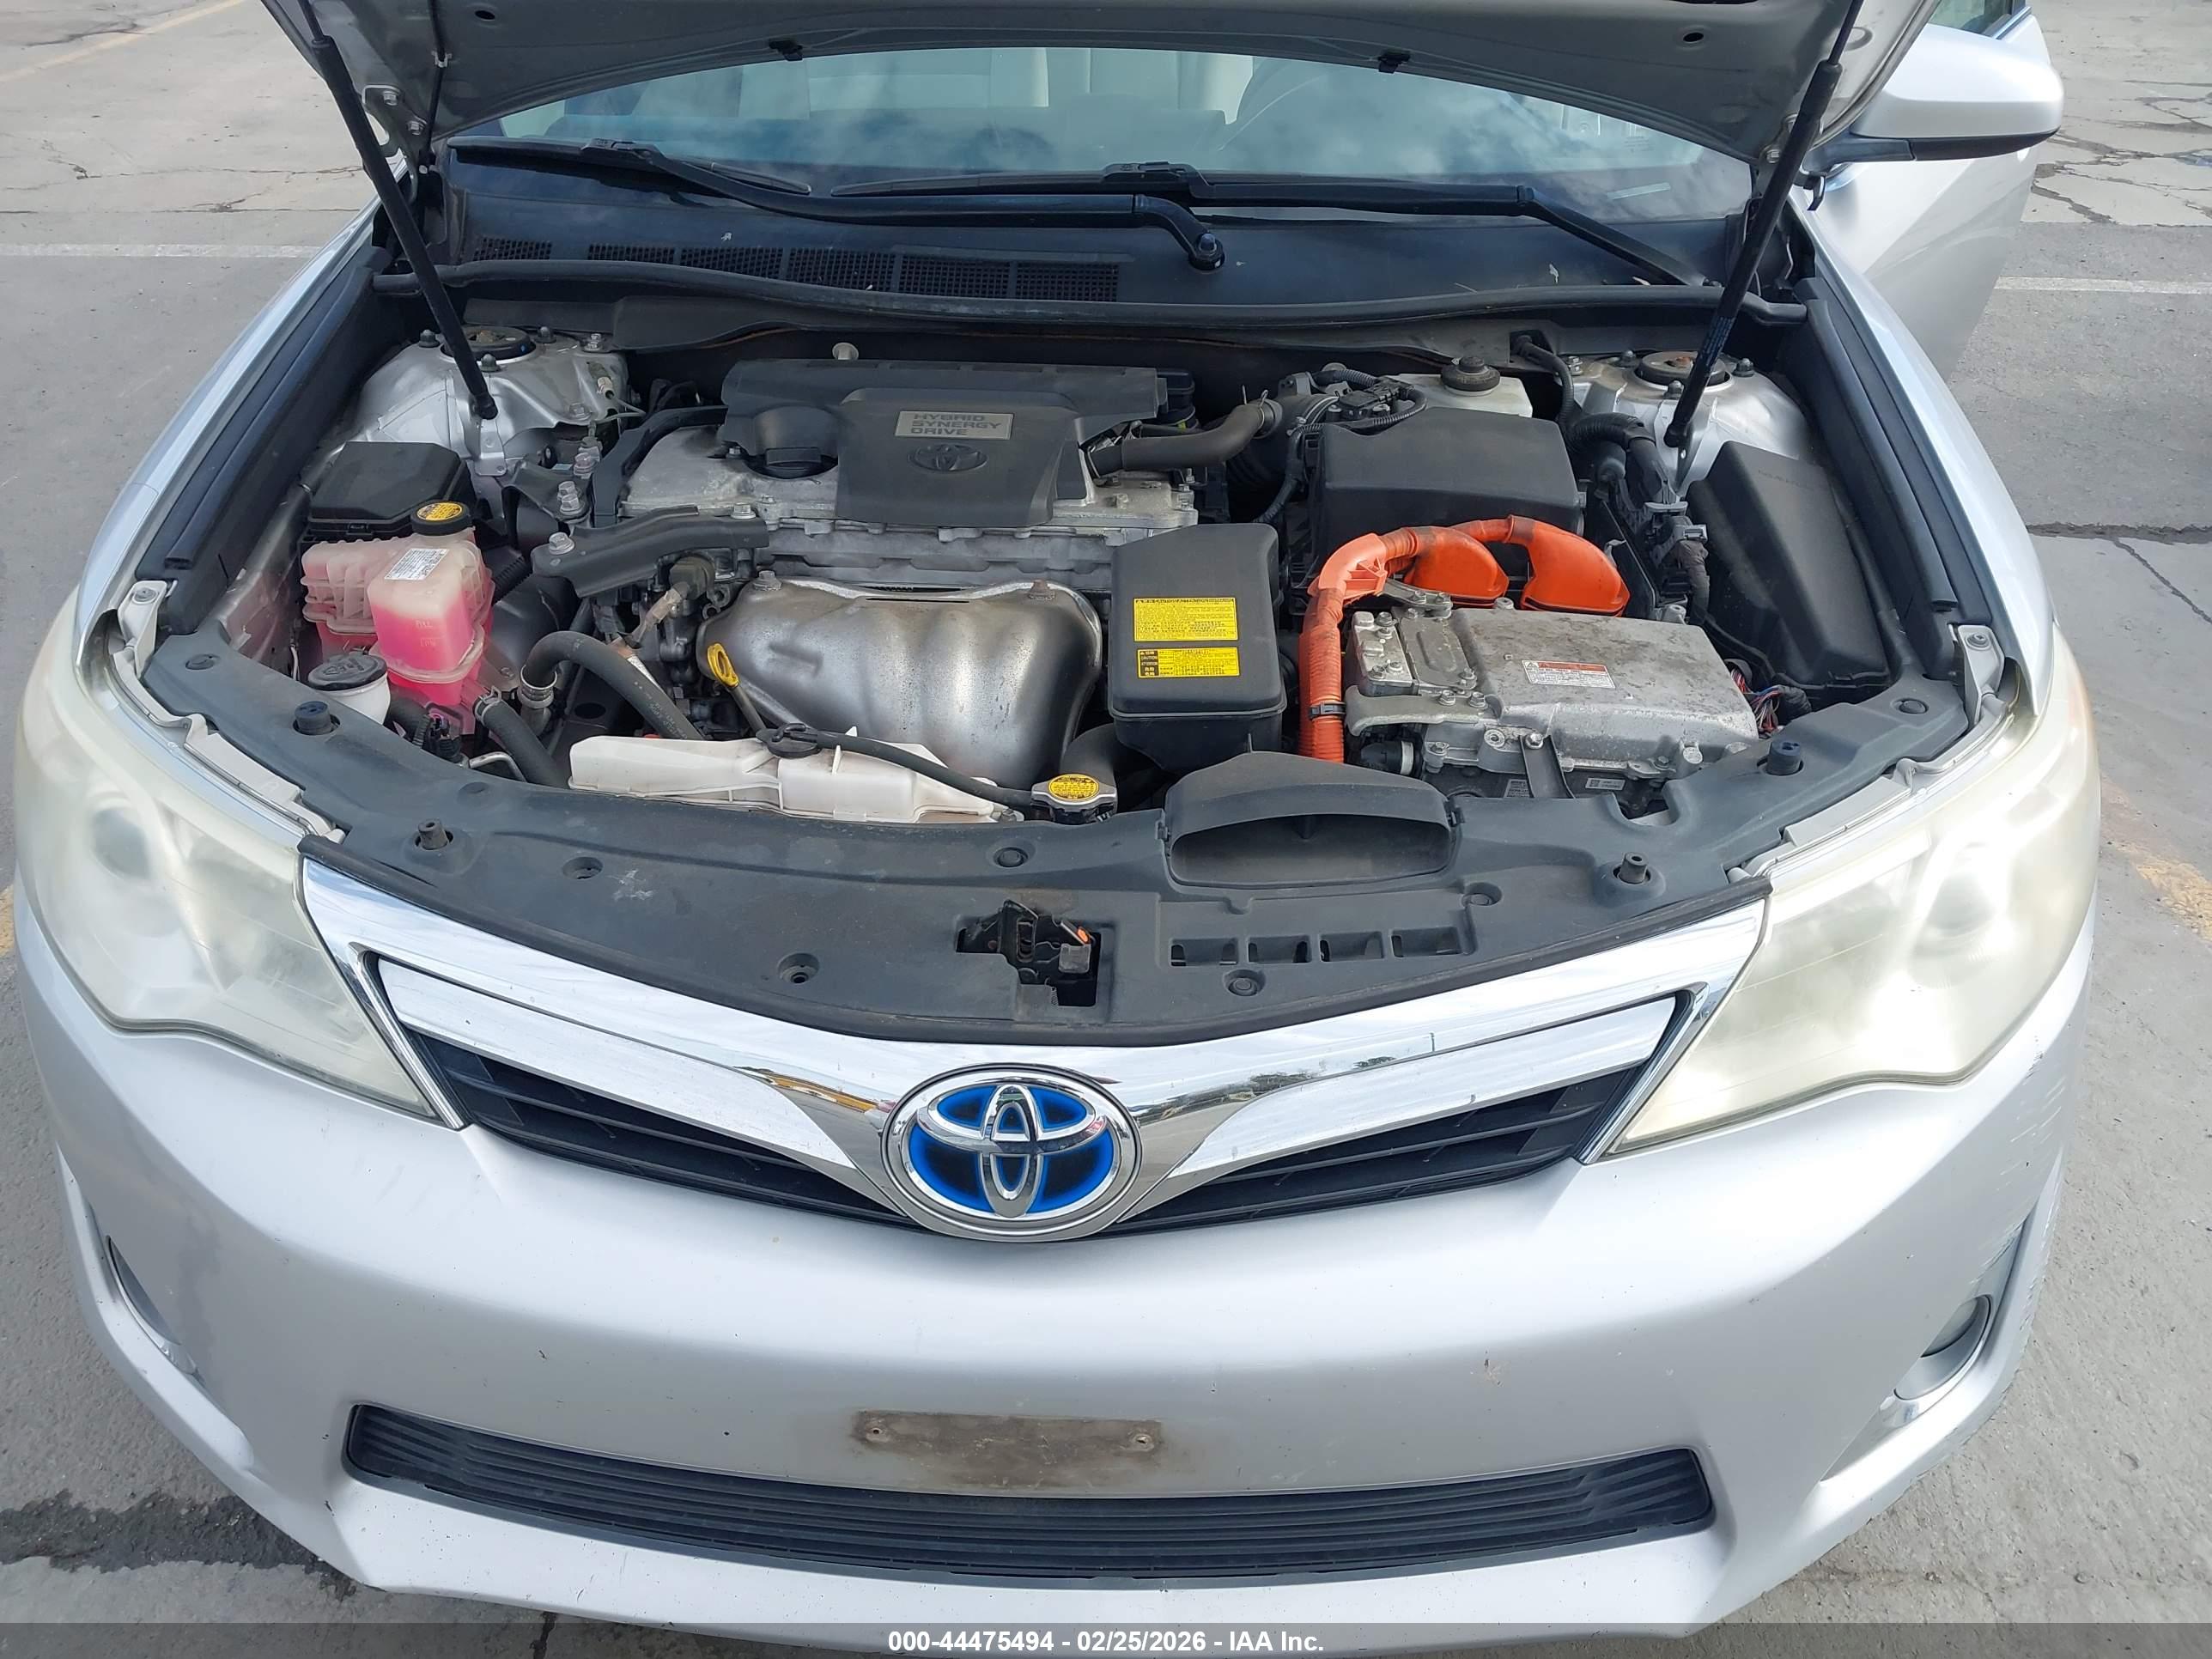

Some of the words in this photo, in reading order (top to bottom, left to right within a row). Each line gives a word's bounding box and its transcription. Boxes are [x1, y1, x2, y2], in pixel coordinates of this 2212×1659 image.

[913, 413, 985, 422] HYBRID
[911, 420, 1002, 429] SYNERGY
[910, 427, 969, 435] DRIVE
